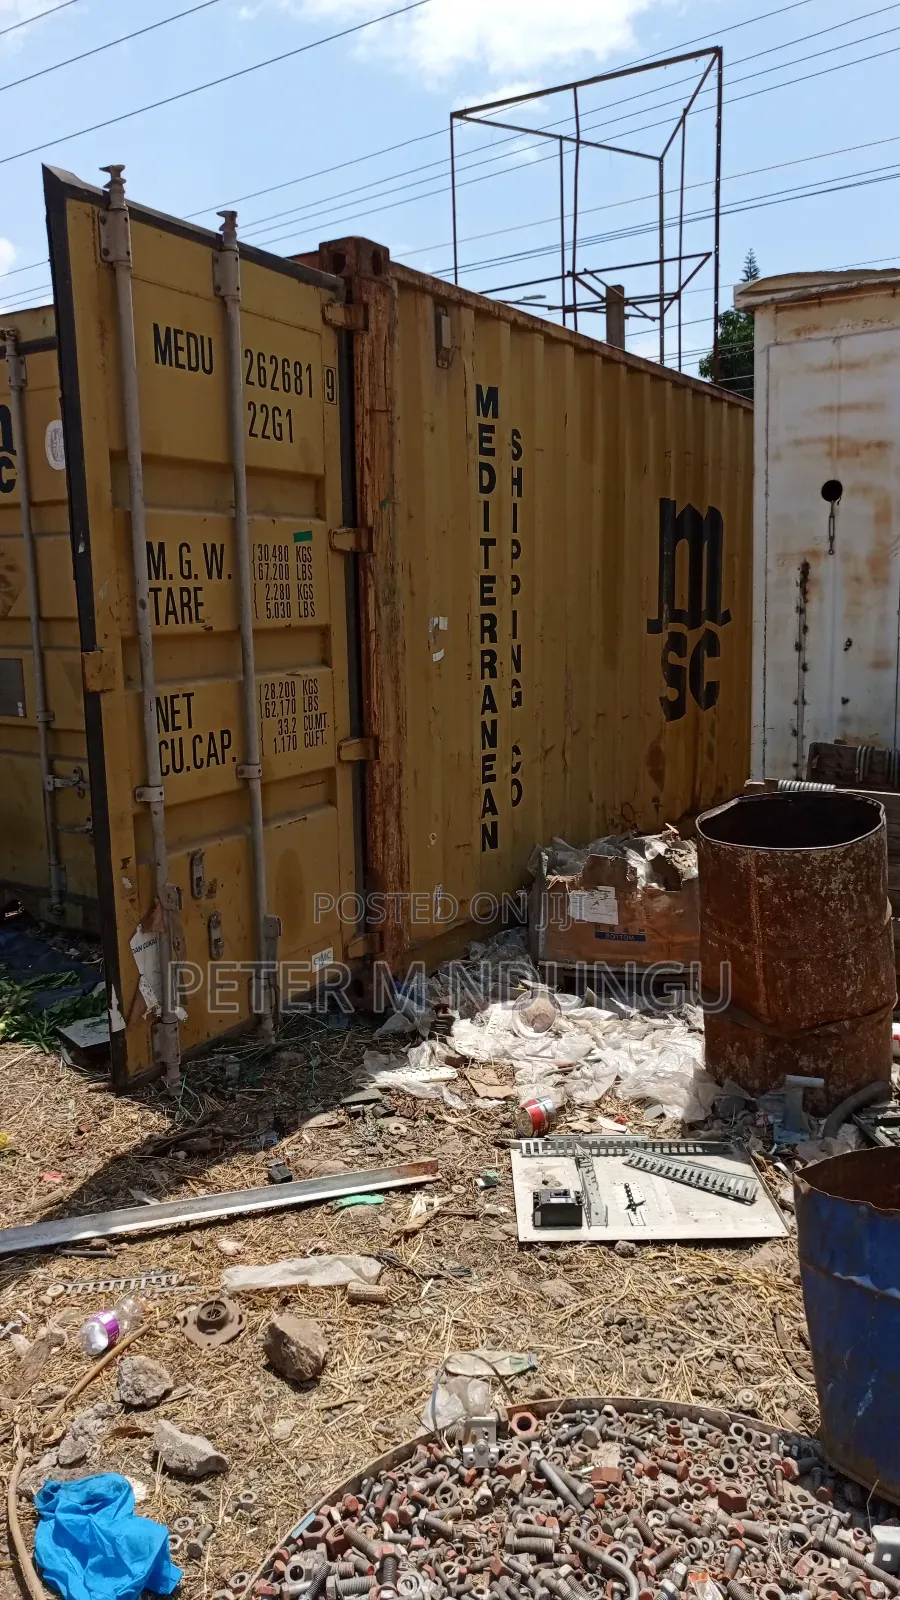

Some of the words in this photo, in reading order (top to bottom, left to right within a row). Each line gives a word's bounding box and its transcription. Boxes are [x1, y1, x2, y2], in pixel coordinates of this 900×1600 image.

[152, 322, 214, 376] MEDU
[244, 348, 313, 399] 262681
[325, 368, 335, 402] 9
[247, 400, 294, 444] 22G1
[295, 545, 313, 564] KGS
[296, 563, 313, 581] LBS
[511, 428, 523, 709] SHIPPING
[149, 586, 207, 626] TARE
[297, 583, 314, 601] KGS
[298, 601, 316, 618] LBS
[475, 383, 499, 853] MEDITERRANEAN
[155, 691, 196, 734] NET
[302, 678, 319, 696] KGS
[303, 695, 319, 713] LBS
[158, 728, 237, 777] CU.CAP.
[277, 717, 297, 736] 33.2
[303, 711, 330, 732] CU.MT.
[304, 729, 328, 749] CU.FT.
[511, 744, 523, 808] CO
